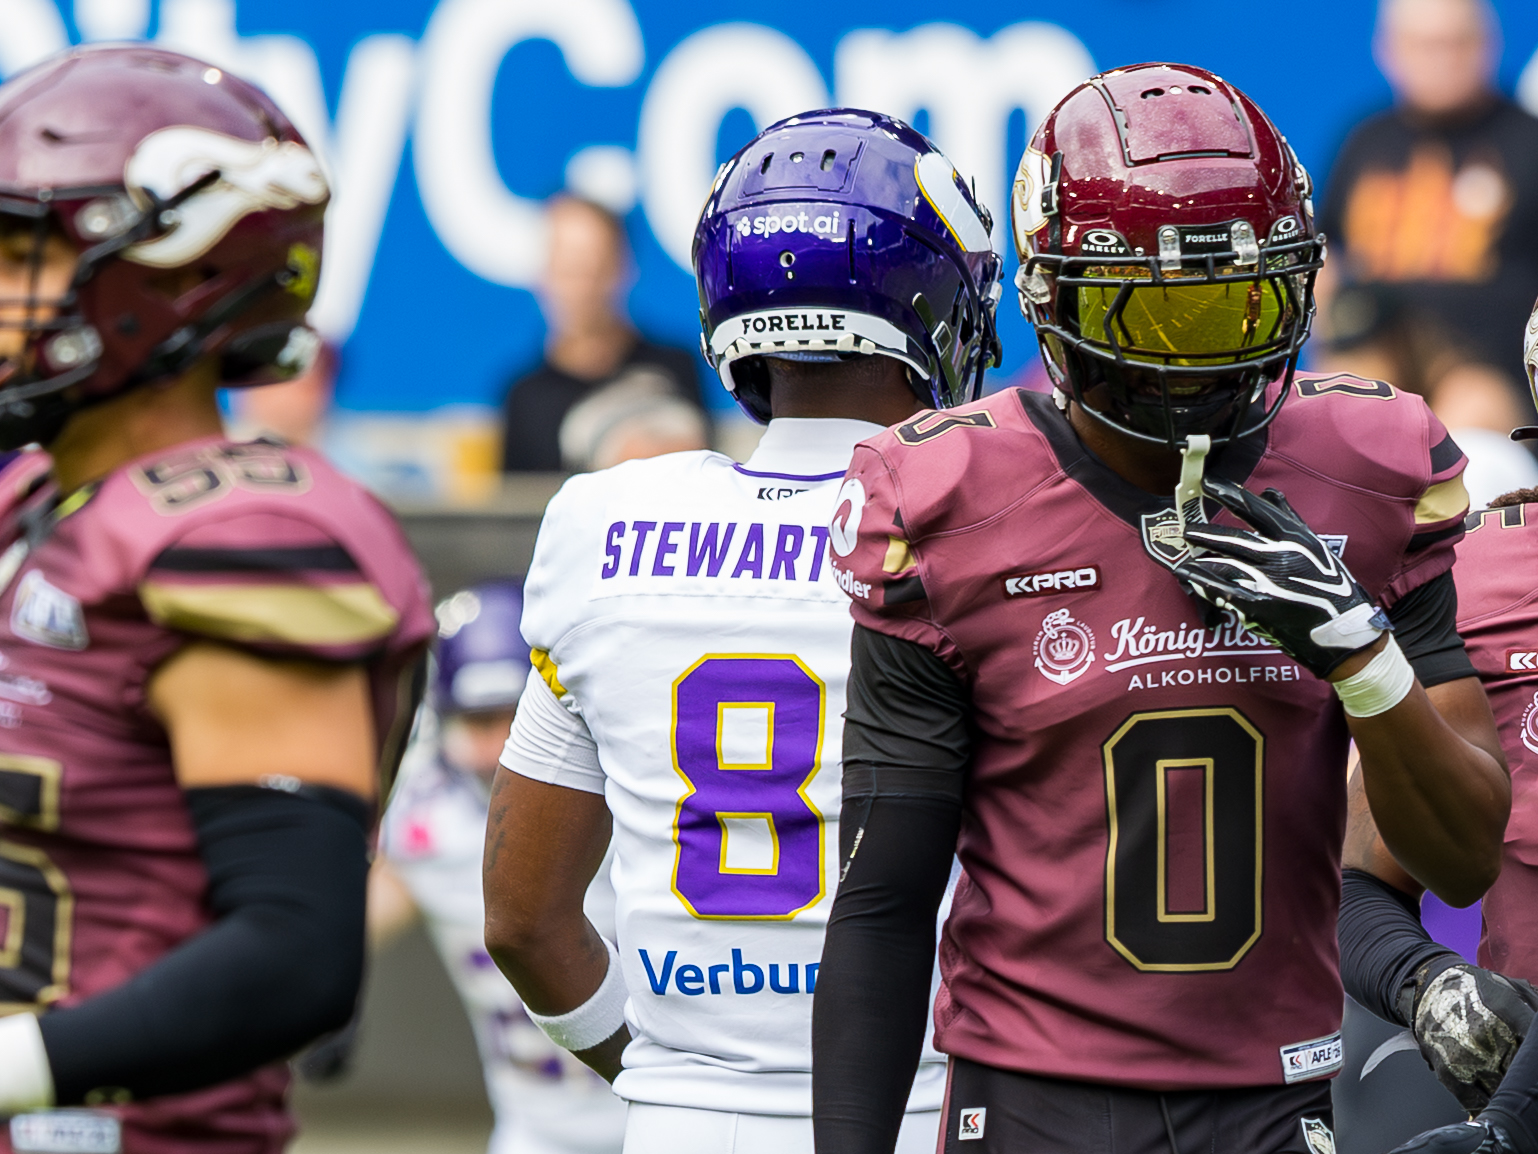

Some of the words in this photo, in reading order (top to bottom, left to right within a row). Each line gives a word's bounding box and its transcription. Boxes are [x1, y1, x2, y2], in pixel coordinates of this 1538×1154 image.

[753, 211, 840, 239] spot.ai
[1185, 232, 1229, 244] FORELLE
[1081, 243, 1126, 254] OAKLEY
[741, 313, 846, 335] FORELLE
[601, 520, 830, 582] STEWART
[1127, 665, 1301, 692] ALKOHOLFREI
[671, 652, 827, 921] 8
[1102, 705, 1266, 973] 0
